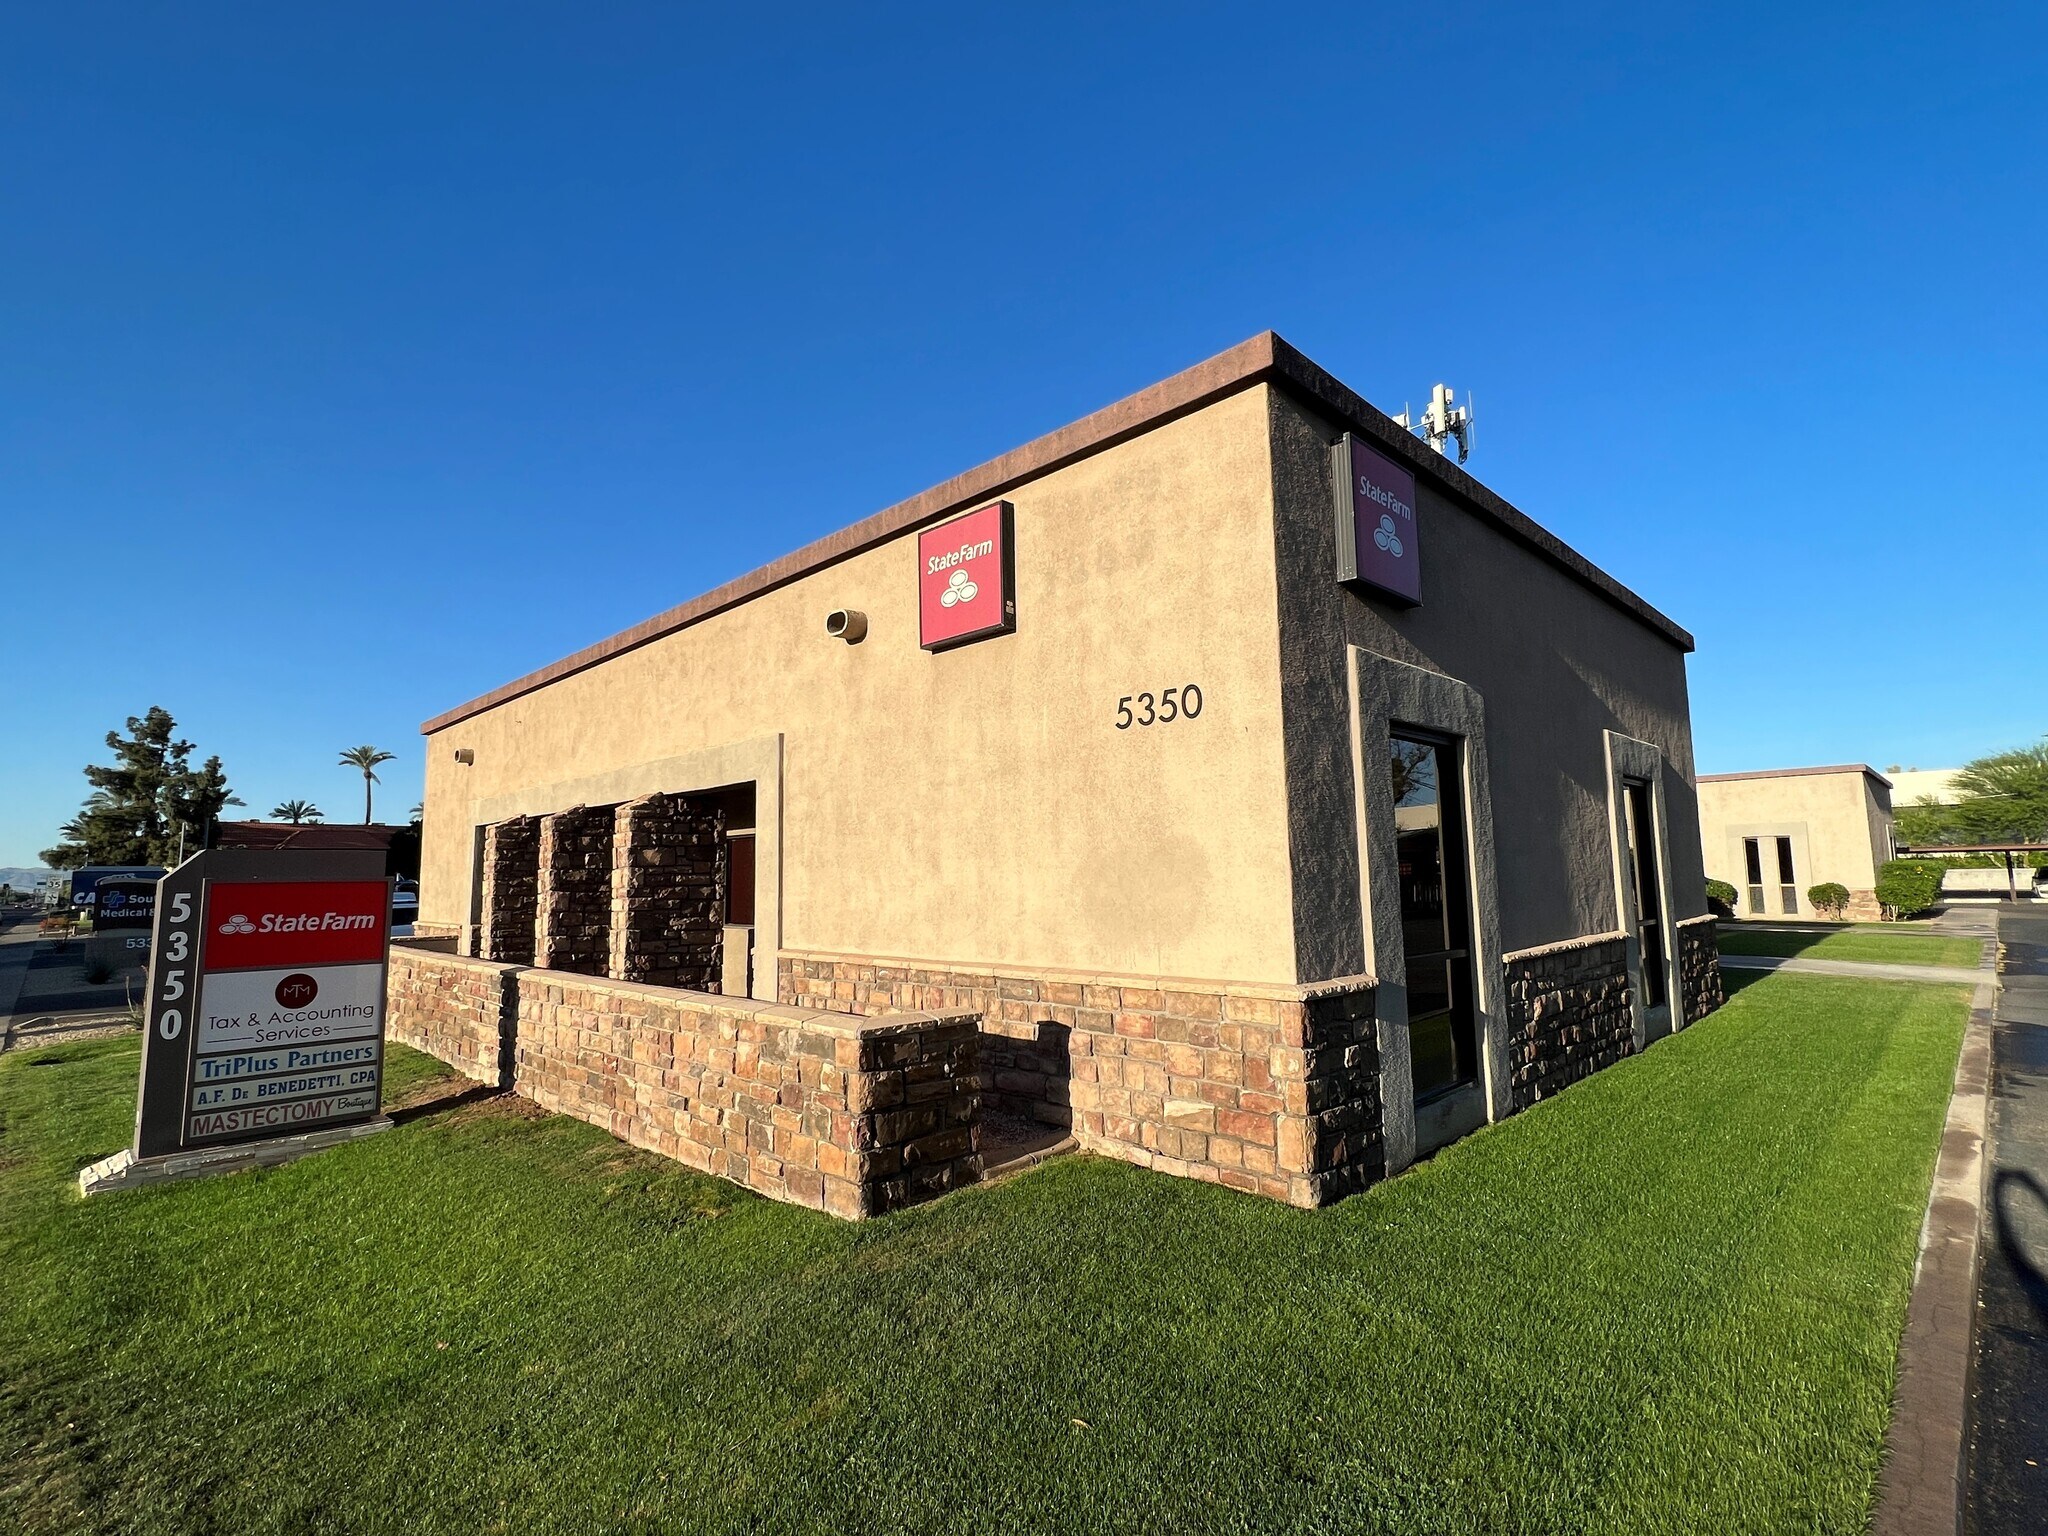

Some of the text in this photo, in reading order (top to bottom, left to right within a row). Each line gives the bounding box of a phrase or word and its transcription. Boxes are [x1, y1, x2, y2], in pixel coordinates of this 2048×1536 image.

[1360, 475, 1411, 521] StateFarm
[927, 539, 993, 575] StateFarm
[1115, 684, 1203, 730] 5350
[101, 908, 147, 918] Medical
[129, 894, 156, 904] Sou
[258, 912, 375, 934] StateFarm
[159, 893, 192, 1040] 5350
[209, 1003, 374, 1030] Tax & Accounting
[255, 1025, 331, 1043] Services
[201, 1046, 373, 1078] TriPlus Partners
[350, 1069, 376, 1084] CPA
[192, 1096, 374, 1136] MASTECTOMY Boutique
